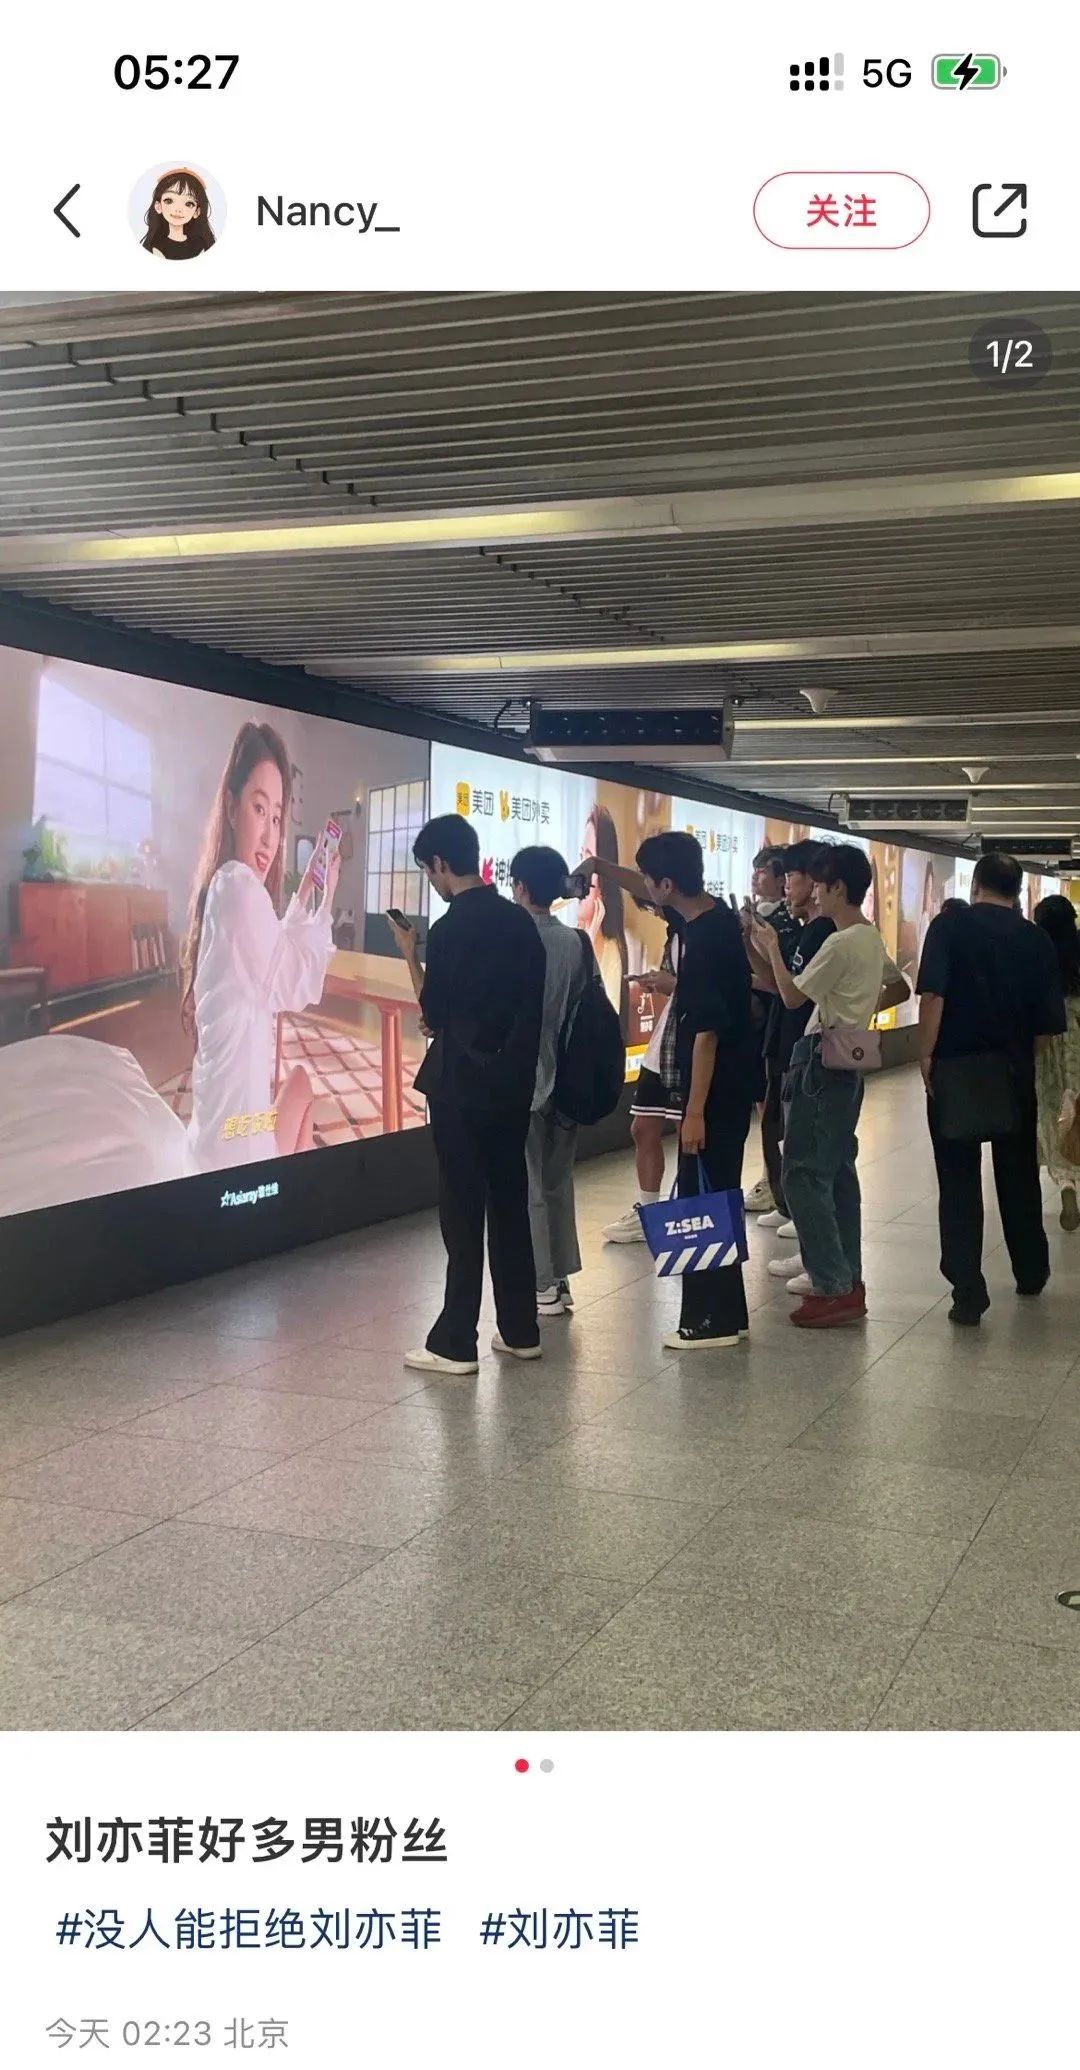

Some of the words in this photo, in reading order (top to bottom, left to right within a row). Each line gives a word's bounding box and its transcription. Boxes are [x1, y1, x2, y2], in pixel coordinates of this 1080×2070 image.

[473, 789, 494, 816] 美团
[511, 796, 550, 825] 美团外卖
[665, 1215, 715, 1236] Z:SEA
